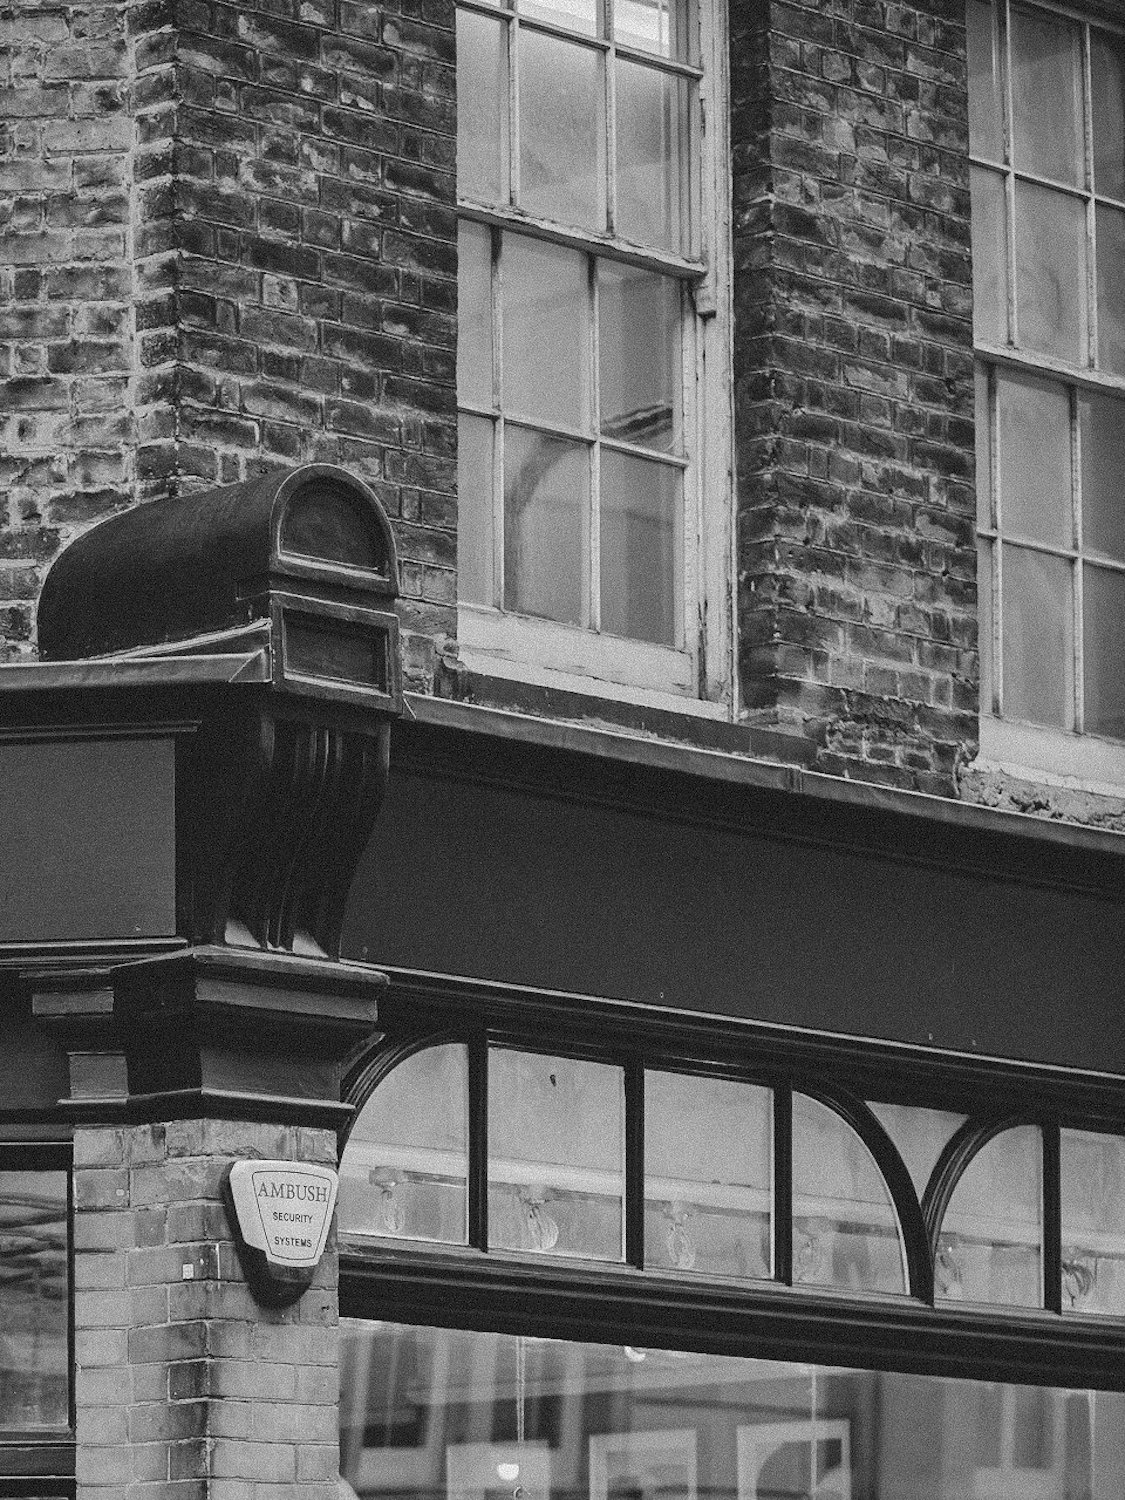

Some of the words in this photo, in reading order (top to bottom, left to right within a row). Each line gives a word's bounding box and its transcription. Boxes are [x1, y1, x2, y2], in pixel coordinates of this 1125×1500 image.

[257, 1182, 328, 1203] AMBUSH
[272, 1211, 313, 1224] SECURITY
[274, 1235, 313, 1248] SYSTEMS
